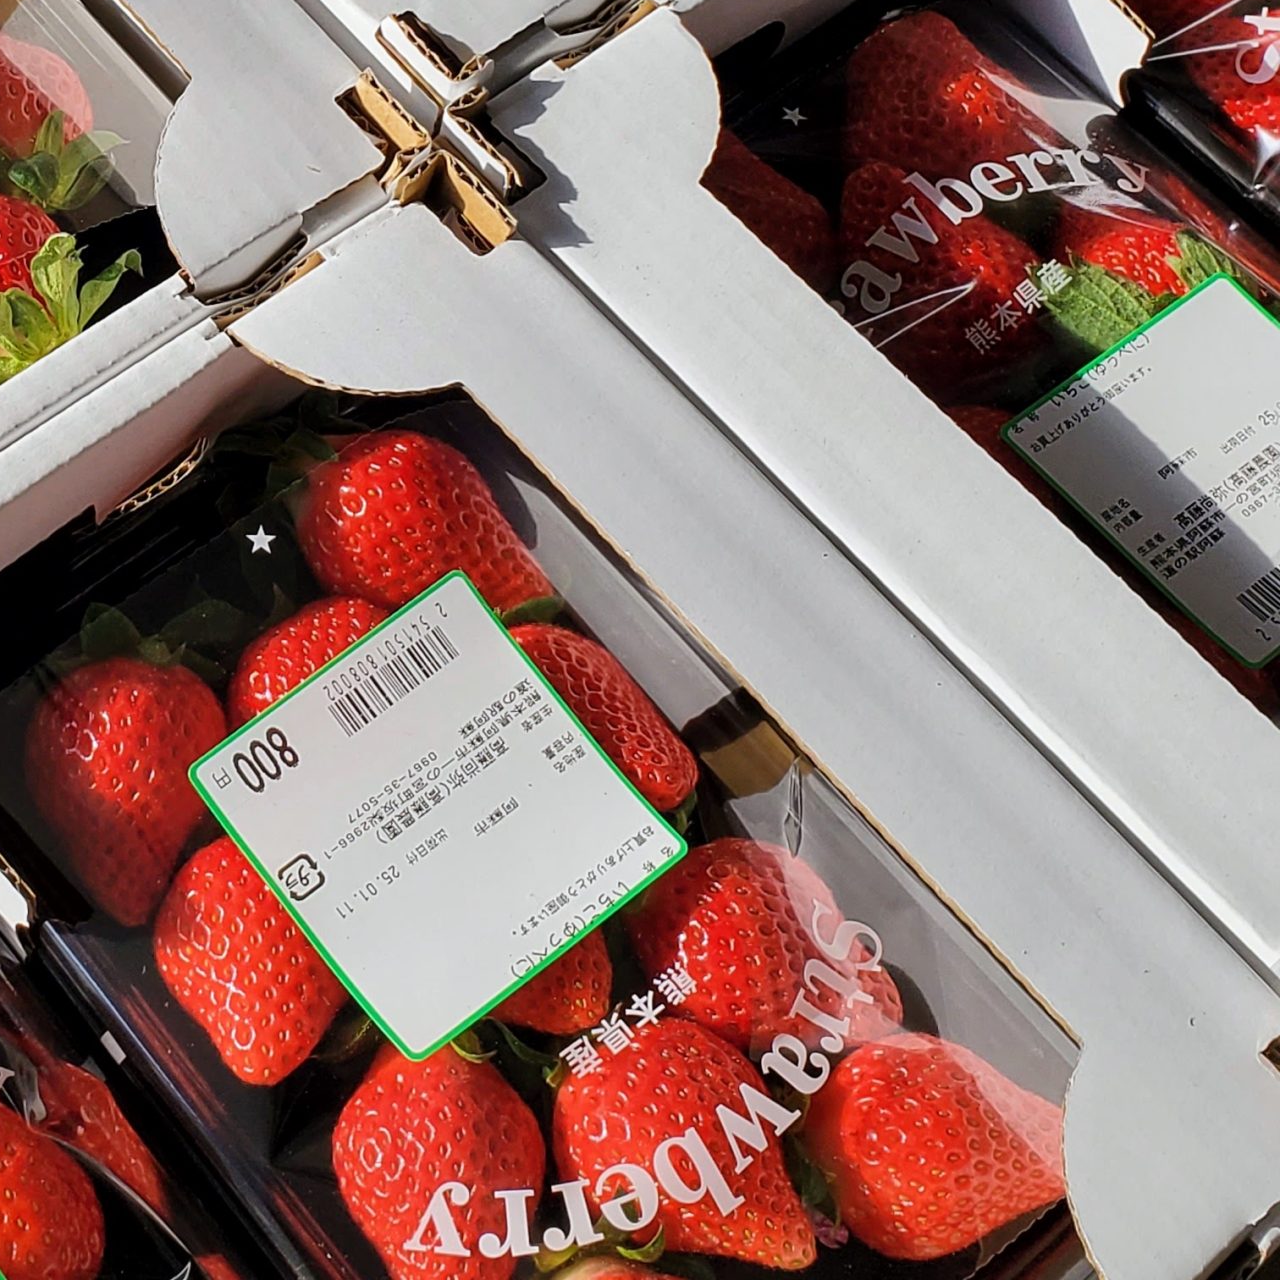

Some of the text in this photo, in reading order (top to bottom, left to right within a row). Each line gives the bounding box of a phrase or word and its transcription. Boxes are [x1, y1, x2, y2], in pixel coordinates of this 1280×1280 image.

[831, 148, 1150, 332] awberry
[964, 258, 1073, 355] 熊本県産
[1100, 498, 1131, 523] 産地名
[1113, 510, 1143, 534] 内容量
[1219, 426, 1256, 454] 出荷日付
[1137, 532, 1167, 557] 生産者
[1160, 528, 1226, 580] 道の駅阿蘇
[233, 727, 299, 793] 800
[348, 678, 533, 824] 道の駅阿蘇 0967-35-5077
[521, 704, 552, 733] 生産者
[336, 731, 574, 919] 内容量 出荷日付 25.01.11
[474, 745, 586, 836] 産地名 阿蘇市
[512, 826, 654, 936] お買上げありがとう御座います。
[558, 962, 698, 1079] 熊本県産
[403, 897, 884, 1259] Strawberry
